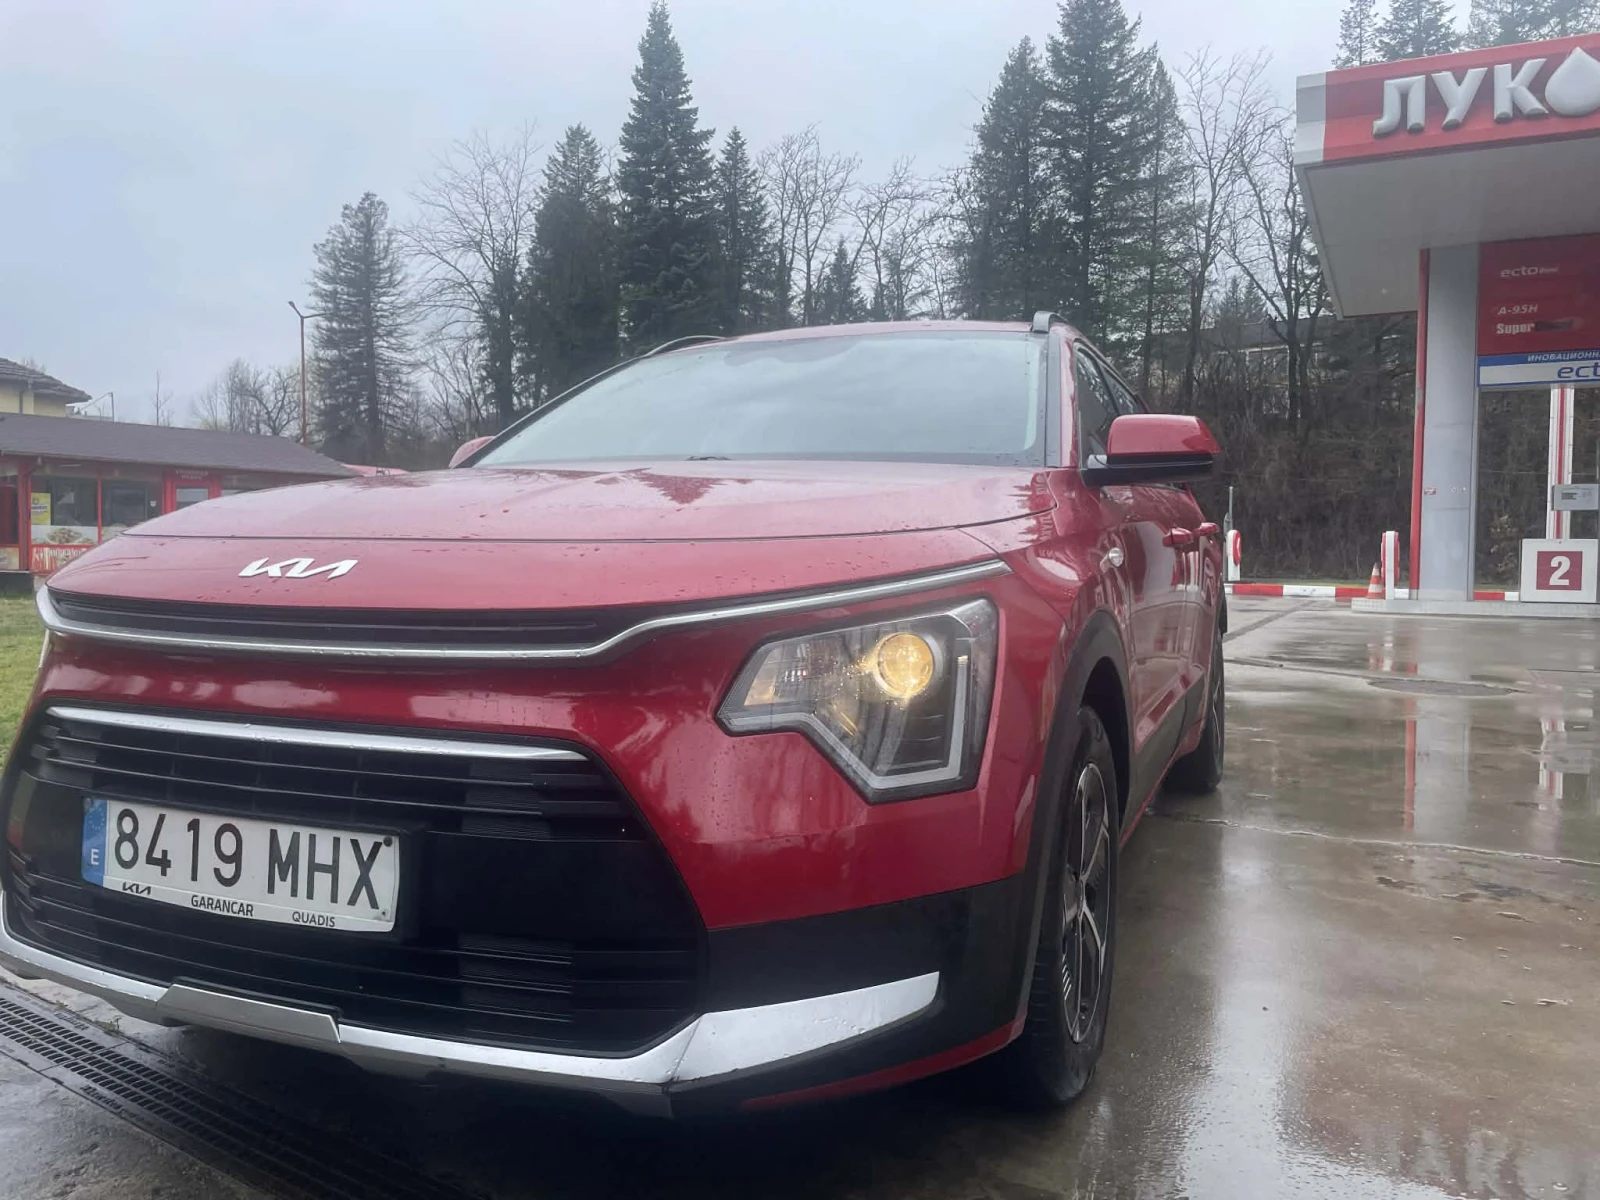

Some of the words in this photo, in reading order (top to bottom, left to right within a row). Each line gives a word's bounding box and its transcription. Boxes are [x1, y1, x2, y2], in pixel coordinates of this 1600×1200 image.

[1500, 266, 1538, 278] ecto
[1496, 323, 1535, 335] Super
[238, 557, 358, 581] KIA
[1549, 555, 1571, 586] 2
[90, 848, 99, 866] E
[114, 807, 243, 888] 8419
[266, 828, 383, 910] MHX
[122, 881, 152, 896] KIA
[190, 894, 254, 918] GARANCAR
[292, 911, 336, 928] QUADIS
